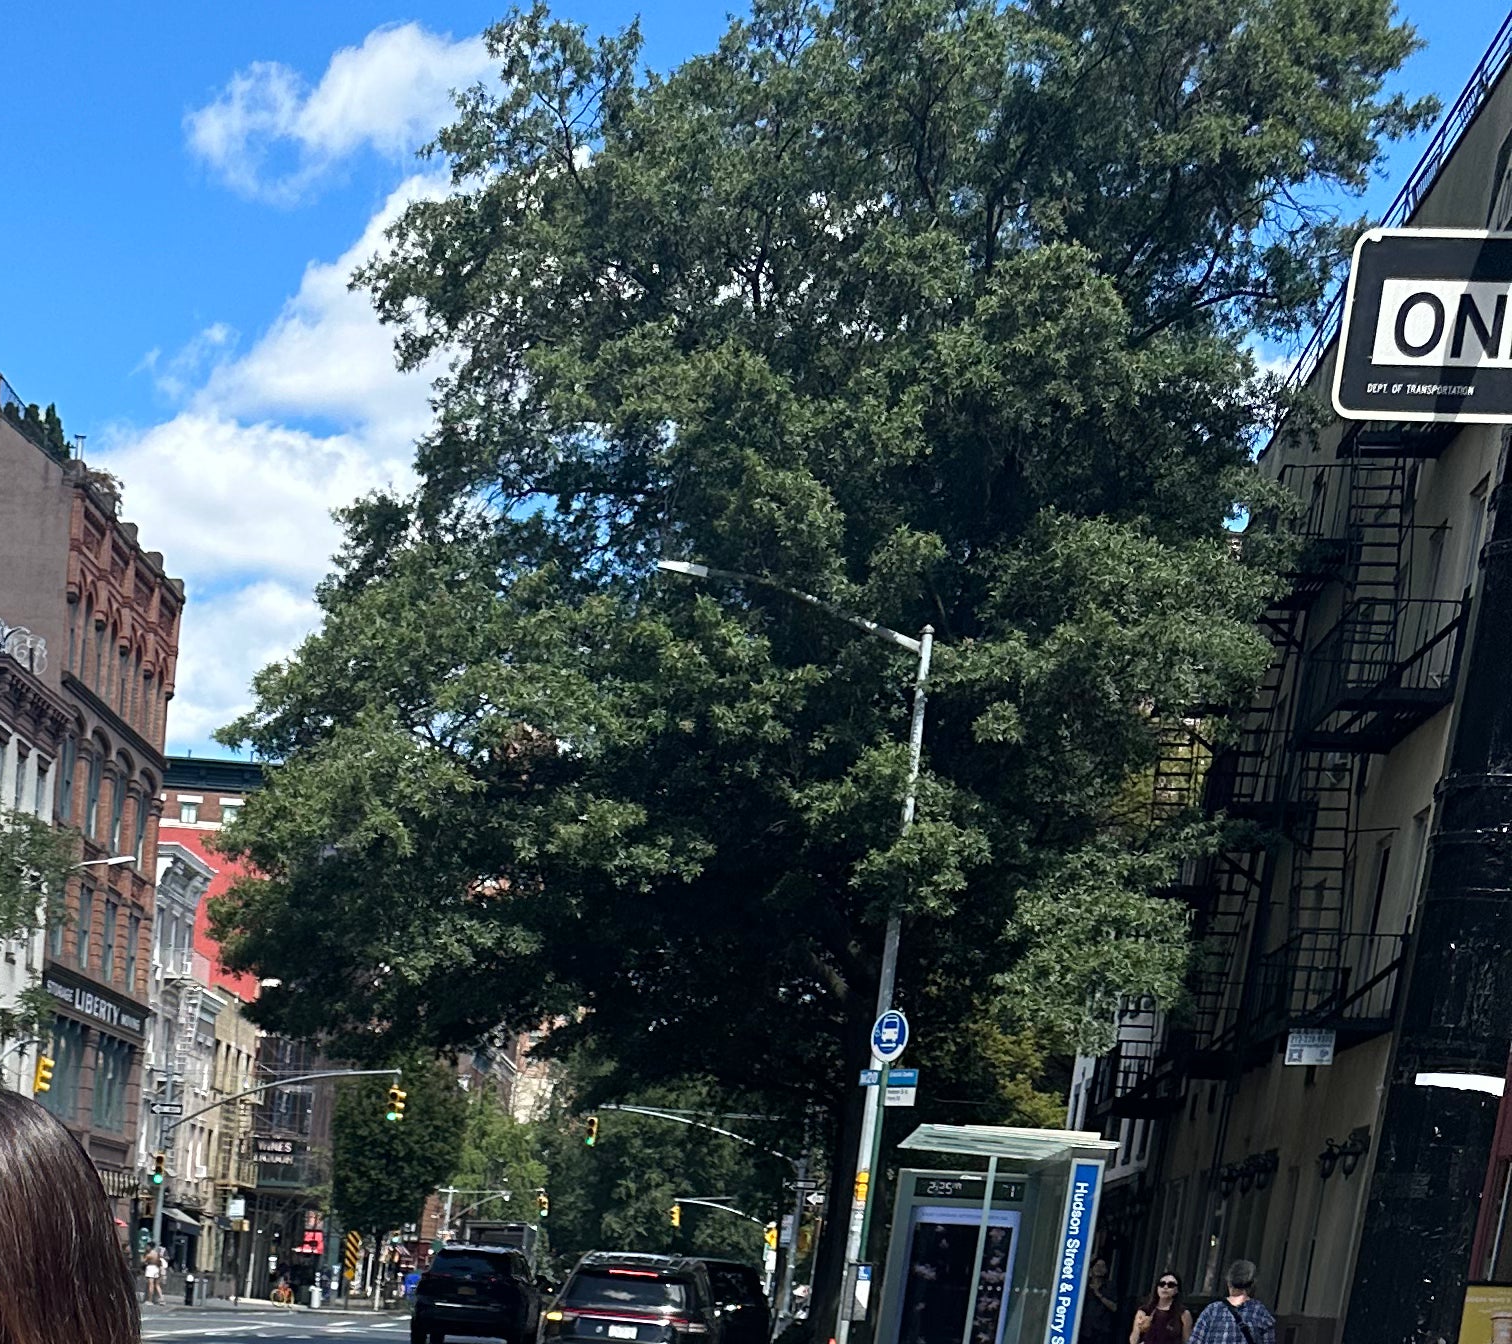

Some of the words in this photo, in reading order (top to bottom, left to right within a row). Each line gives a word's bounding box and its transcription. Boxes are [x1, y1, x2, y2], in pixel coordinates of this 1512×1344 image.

[1394, 291, 1512, 359] ON
[1391, 384, 1404, 394] OF
[1406, 384, 1475, 396] TRANSPORTATION
[74, 988, 120, 1026] LIBERTY
[257, 1141, 292, 1153] WINES
[1067, 1182, 1089, 1235] Hudson
[1060, 1238, 1081, 1279] Street
[1059, 1283, 1074, 1293] &
[1050, 1296, 1072, 1333] Perry
